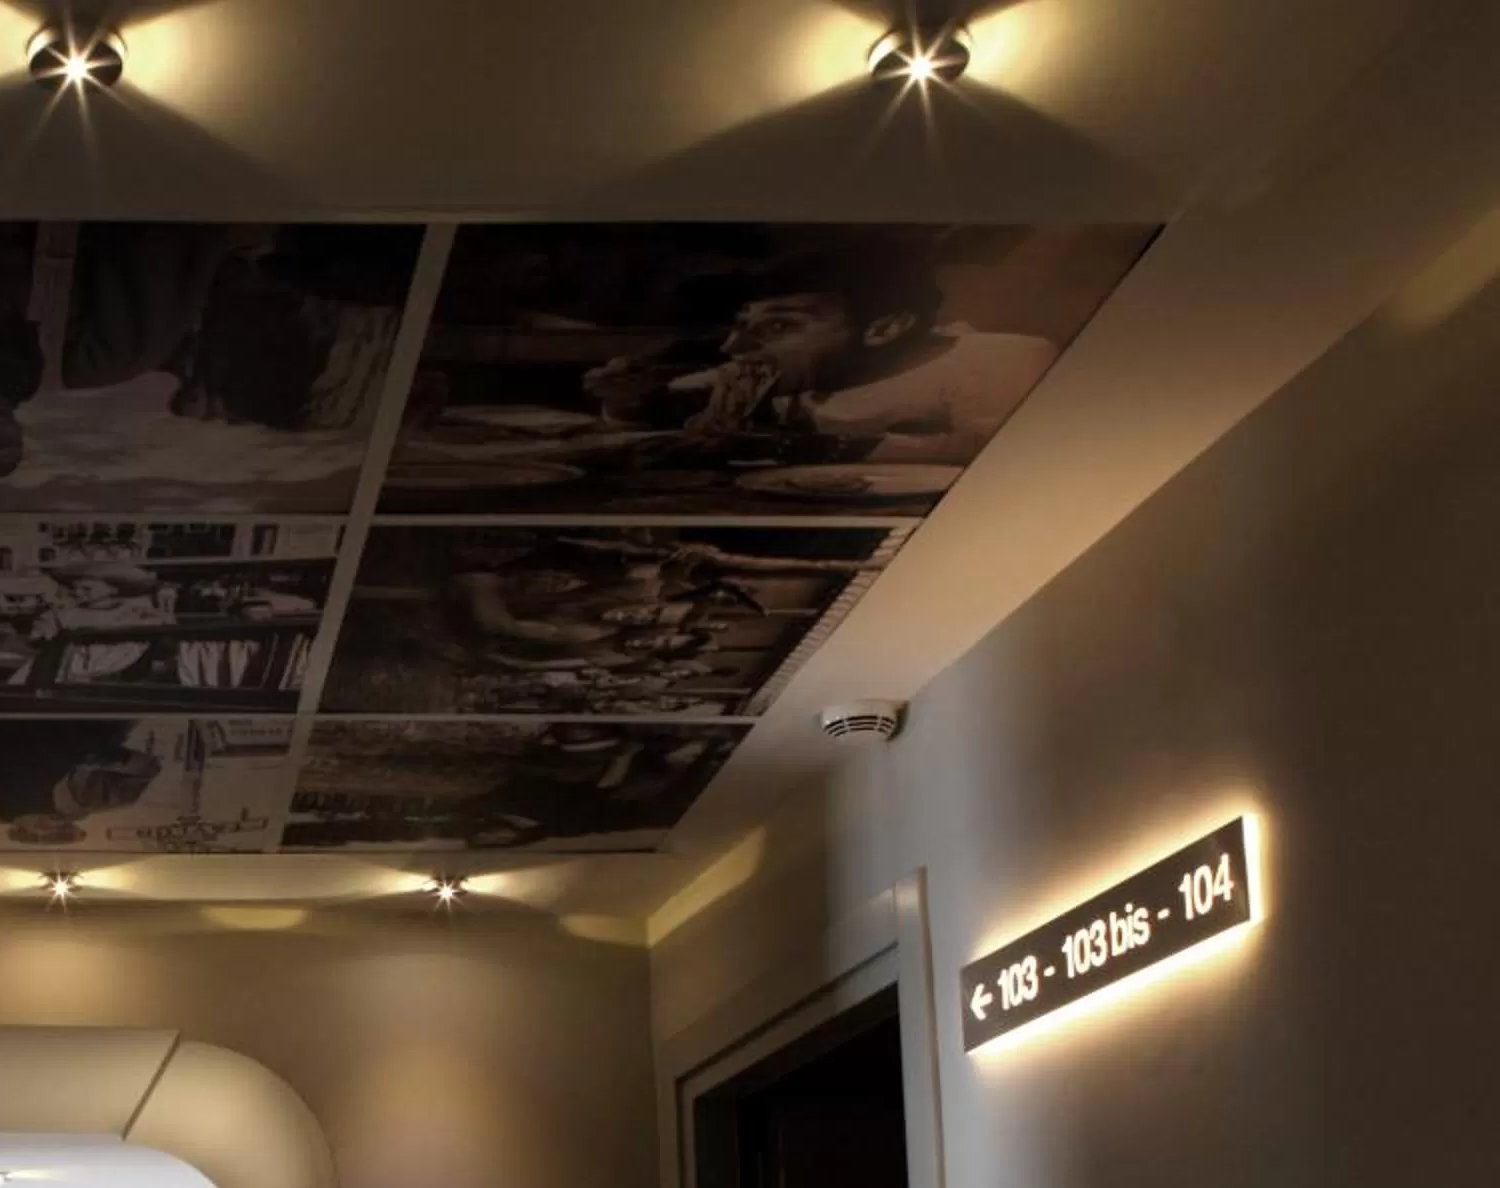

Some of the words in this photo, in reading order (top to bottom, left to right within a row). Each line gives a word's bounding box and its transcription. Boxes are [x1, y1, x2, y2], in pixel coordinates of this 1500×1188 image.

[997, 955, 1039, 1011] 103
[1061, 919, 1109, 979] 103
[1109, 902, 1151, 957] bis
[1178, 853, 1235, 920] 104
